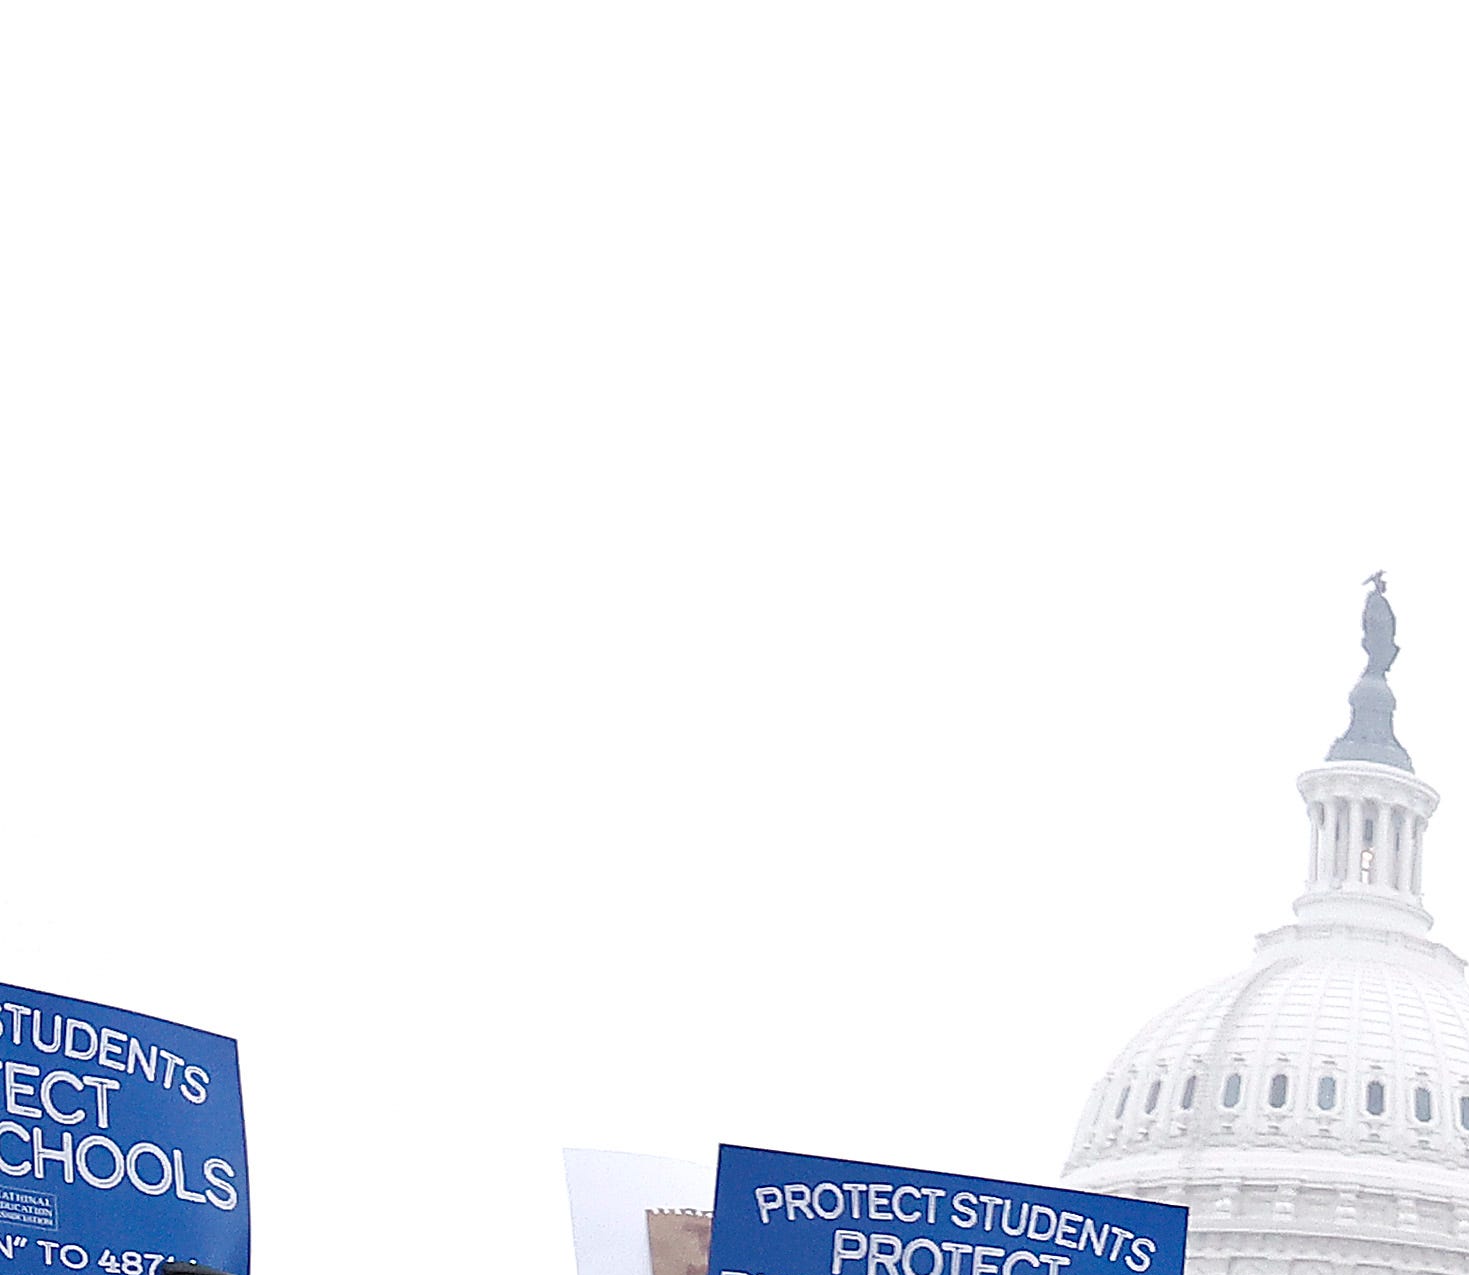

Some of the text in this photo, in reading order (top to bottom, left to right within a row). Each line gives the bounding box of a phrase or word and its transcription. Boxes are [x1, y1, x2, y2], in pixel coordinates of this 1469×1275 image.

[0, 1001, 210, 1104] TUDENTS
[0, 1120, 238, 1211] CHOOLS
[37, 1239, 88, 1269] TO
[755, 1183, 1155, 1272] PROTECT STUDENTS
